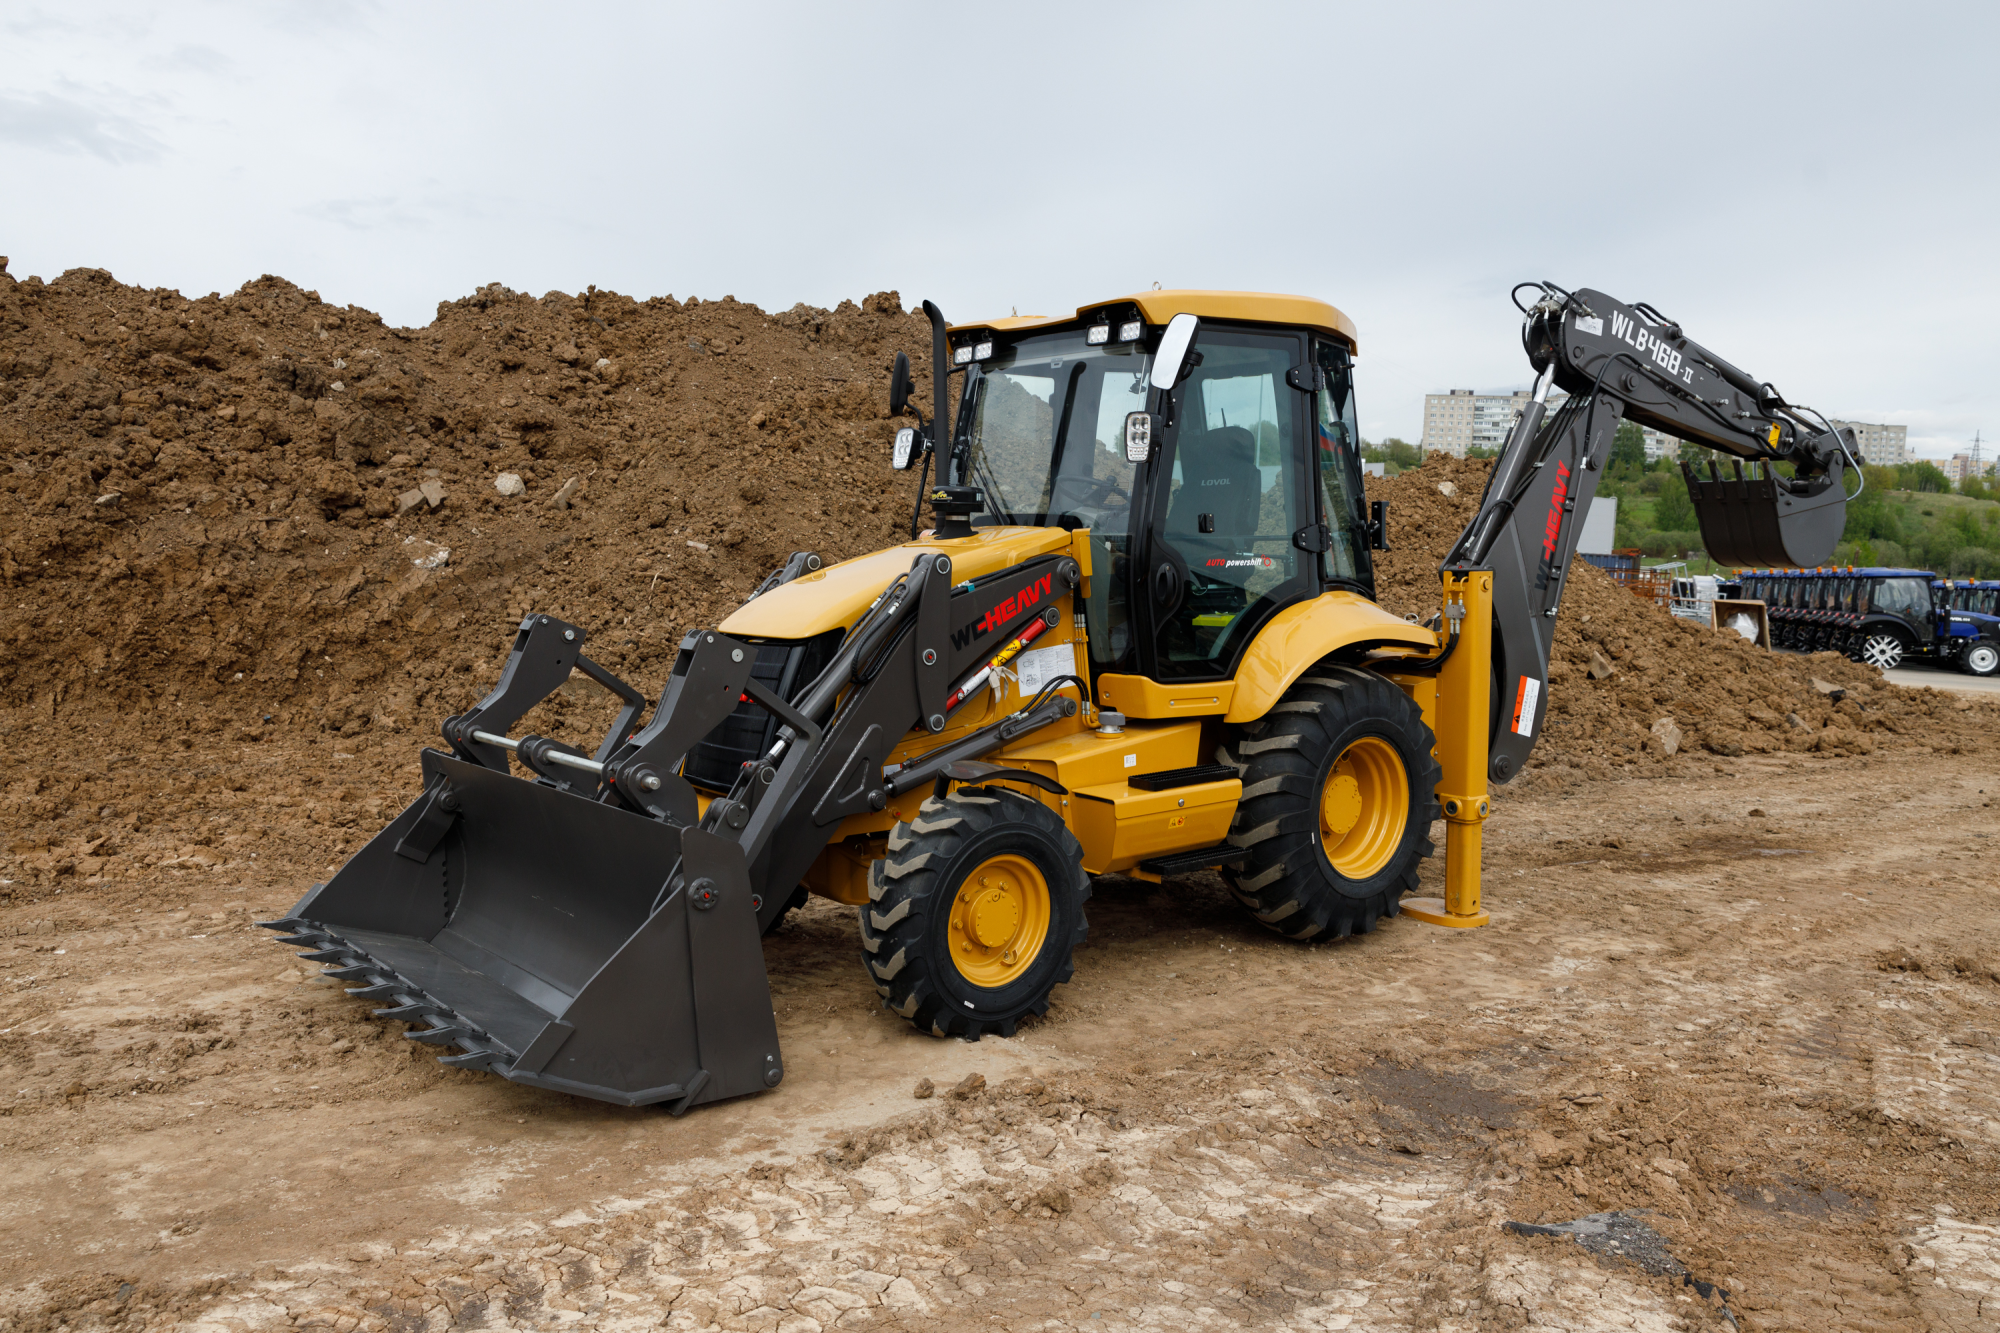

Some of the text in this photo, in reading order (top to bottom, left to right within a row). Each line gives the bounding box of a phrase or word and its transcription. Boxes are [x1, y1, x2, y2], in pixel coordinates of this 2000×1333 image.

[1201, 478, 1230, 487] LOVOL
[1206, 558, 1262, 569] AUTO powershift
